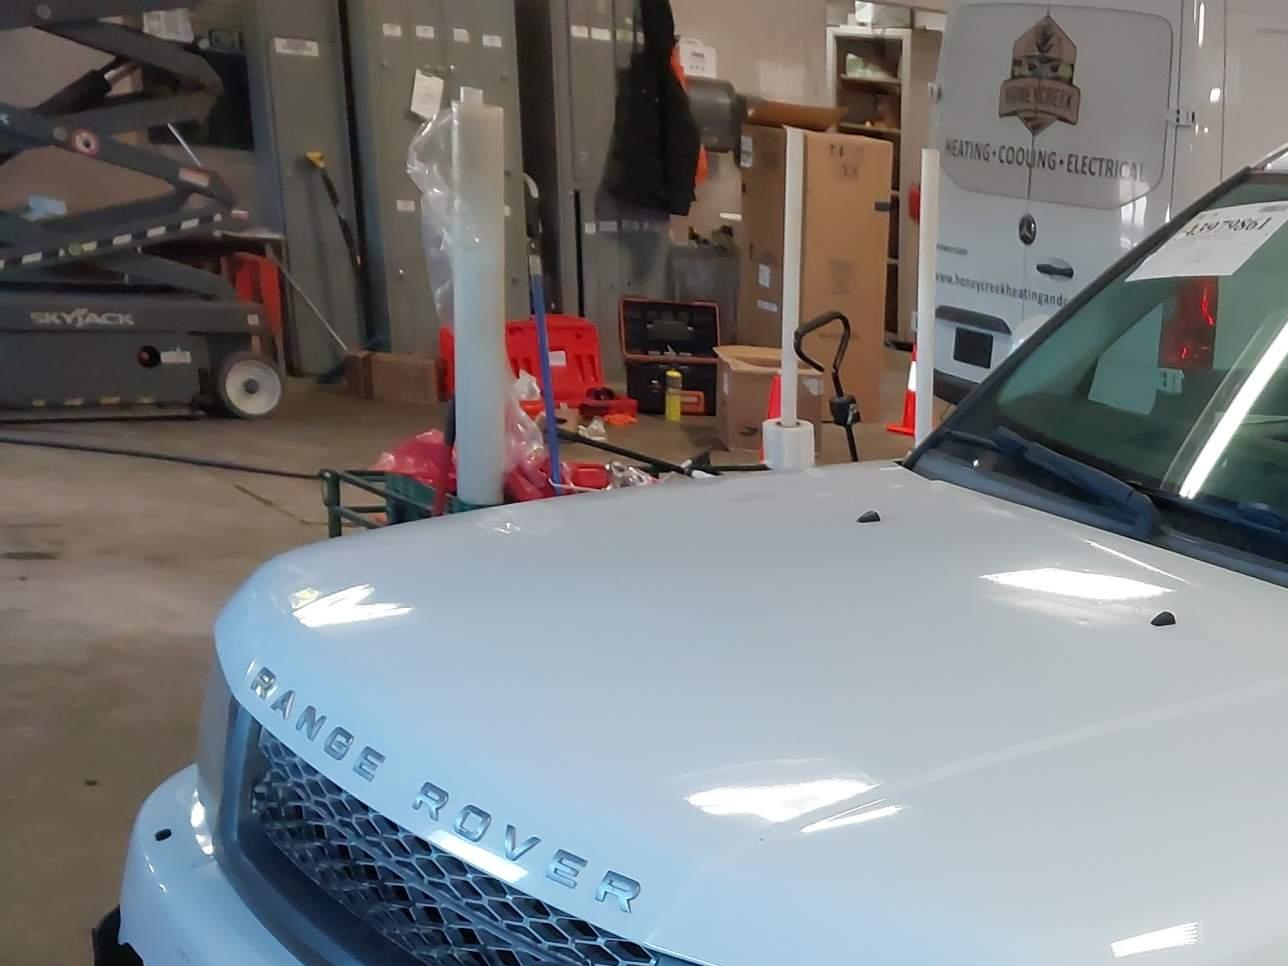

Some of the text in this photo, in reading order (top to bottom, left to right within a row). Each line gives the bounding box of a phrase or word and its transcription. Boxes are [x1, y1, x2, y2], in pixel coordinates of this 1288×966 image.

[946, 138, 1145, 183] HEATING COOLING ELECTRICAL
[30, 307, 135, 328] SKYJACK
[250, 666, 642, 915] RANGE ROVER
